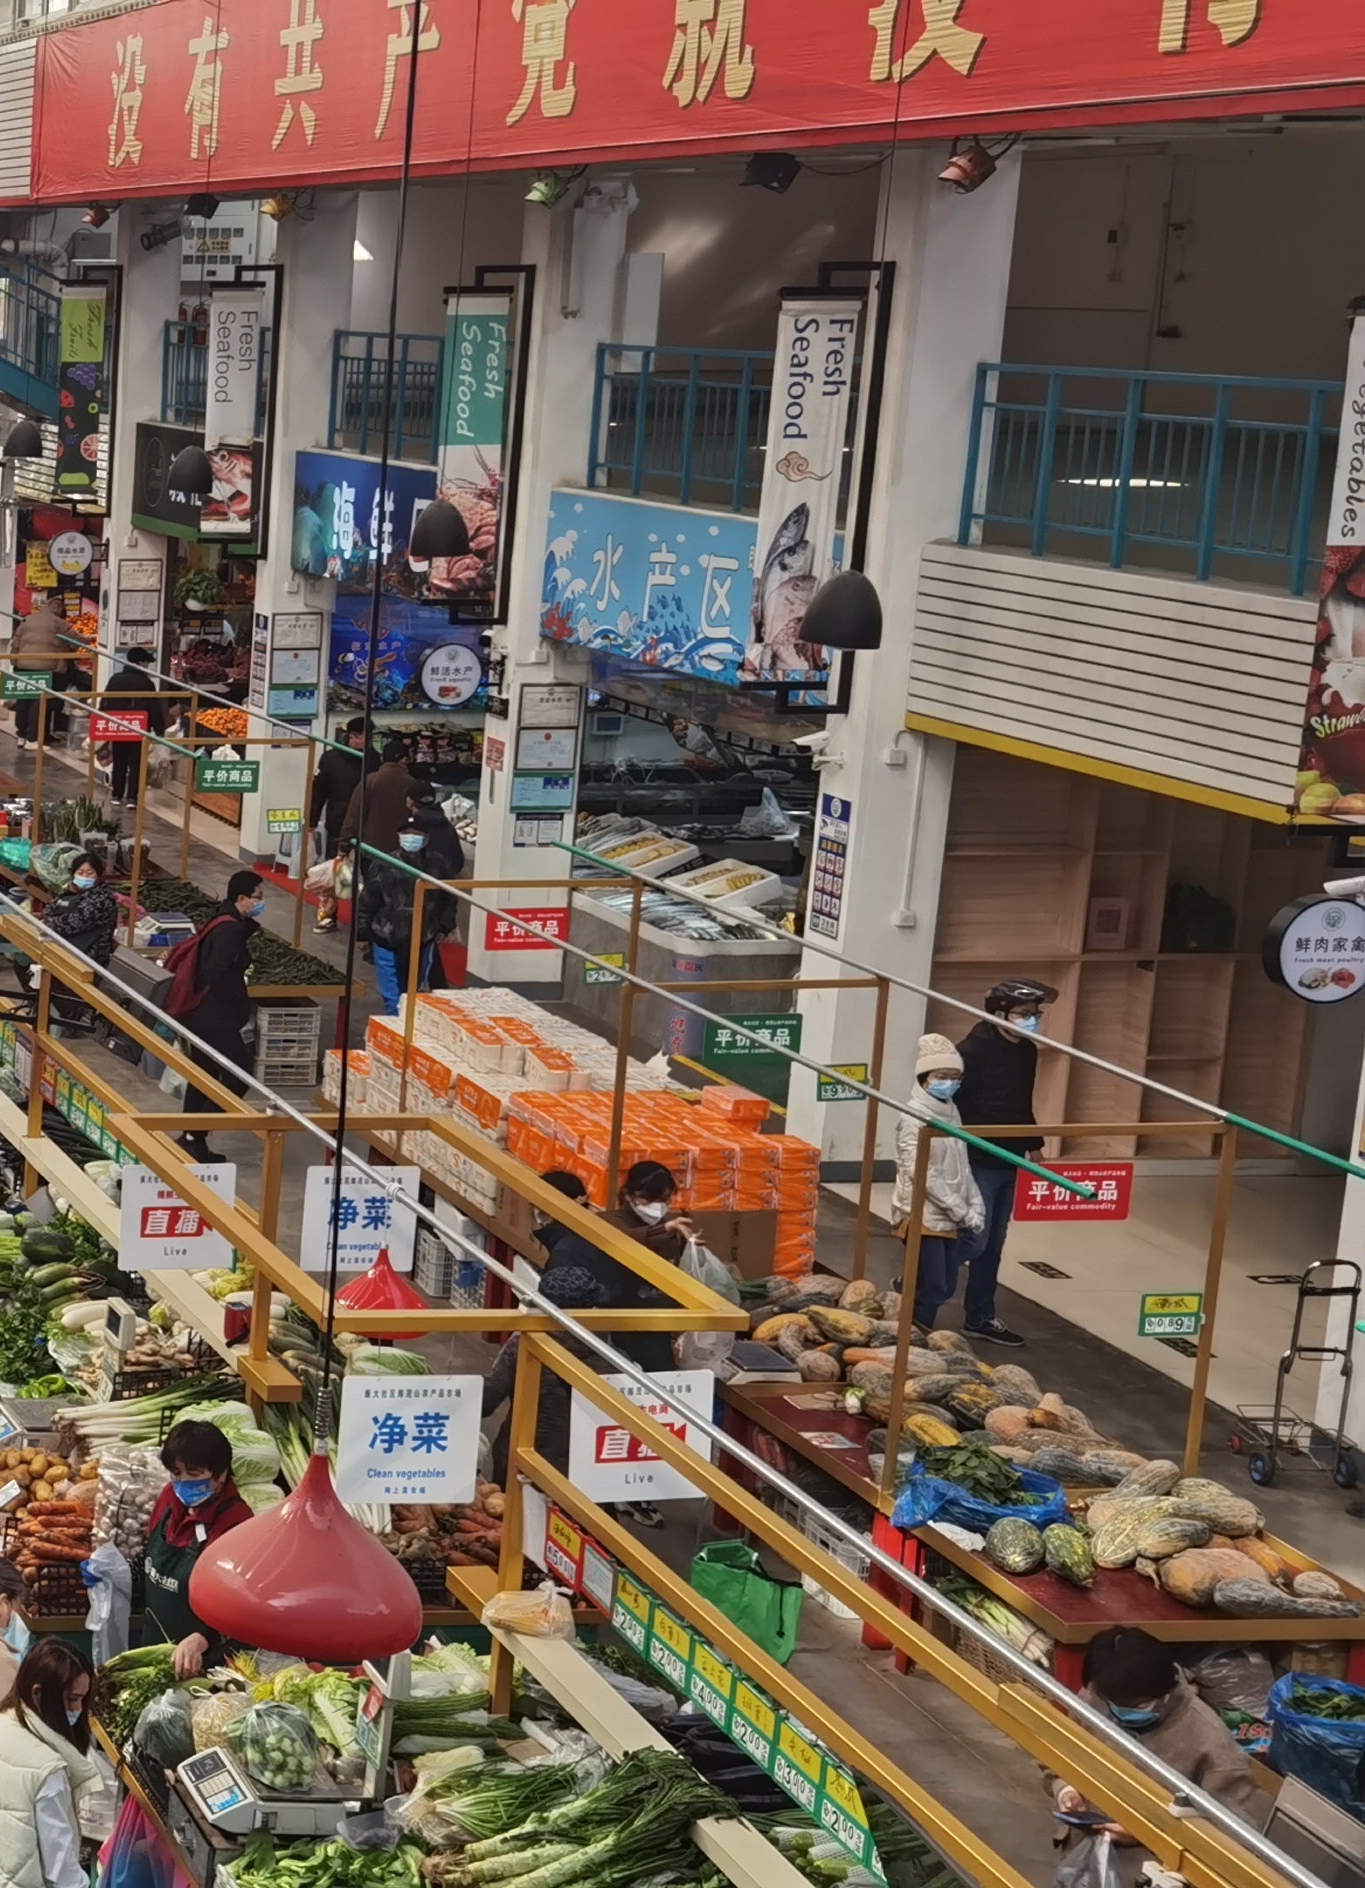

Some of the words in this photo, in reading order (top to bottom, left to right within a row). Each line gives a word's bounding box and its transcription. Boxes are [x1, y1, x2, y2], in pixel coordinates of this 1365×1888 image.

[213, 309, 236, 404] Seafood
[238, 309, 259, 372] Fresh
[821, 317, 854, 397] Fresh
[482, 320, 506, 400] Fresh
[456, 320, 482, 438] Seafood
[782, 317, 819, 440] Seafood
[589, 534, 738, 639] 水产区
[430, 665, 474, 677] 鲜活水产
[202, 769, 254, 784] 平价商品
[1294, 935, 1365, 954] 鲜肉家禽
[143, 1208, 201, 1236] 直播
[1070, 1203, 1117, 1211] commodity
[163, 1246, 188, 1257] Live
[368, 1411, 451, 1455] 净菜
[366, 1468, 393, 1479] Clean
[395, 1468, 447, 1481] vegetables
[624, 1473, 654, 1485] Live
